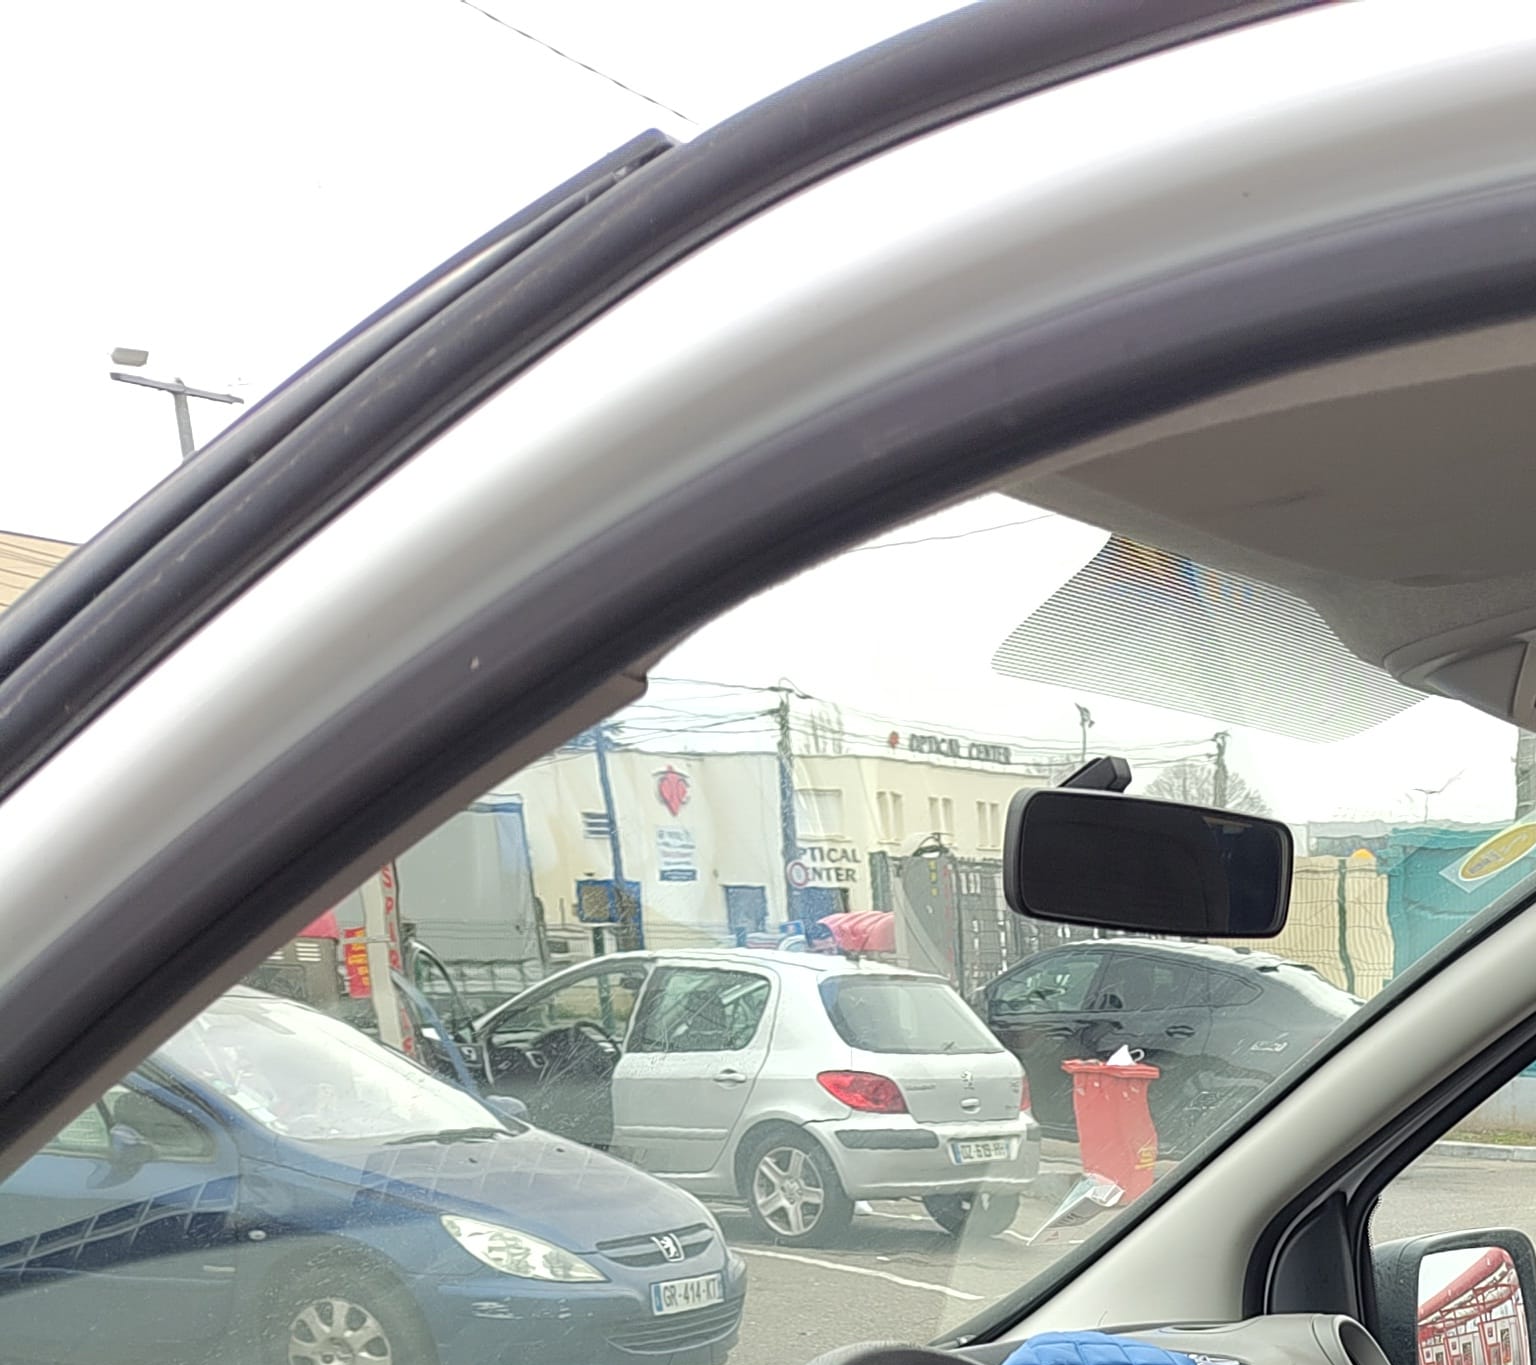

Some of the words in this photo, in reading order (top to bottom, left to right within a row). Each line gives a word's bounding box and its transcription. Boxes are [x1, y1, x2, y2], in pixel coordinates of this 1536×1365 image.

[908, 733, 960, 758] OPTICAL
[968, 742, 1011, 764] CENTER
[800, 846, 861, 863] PTICAL
